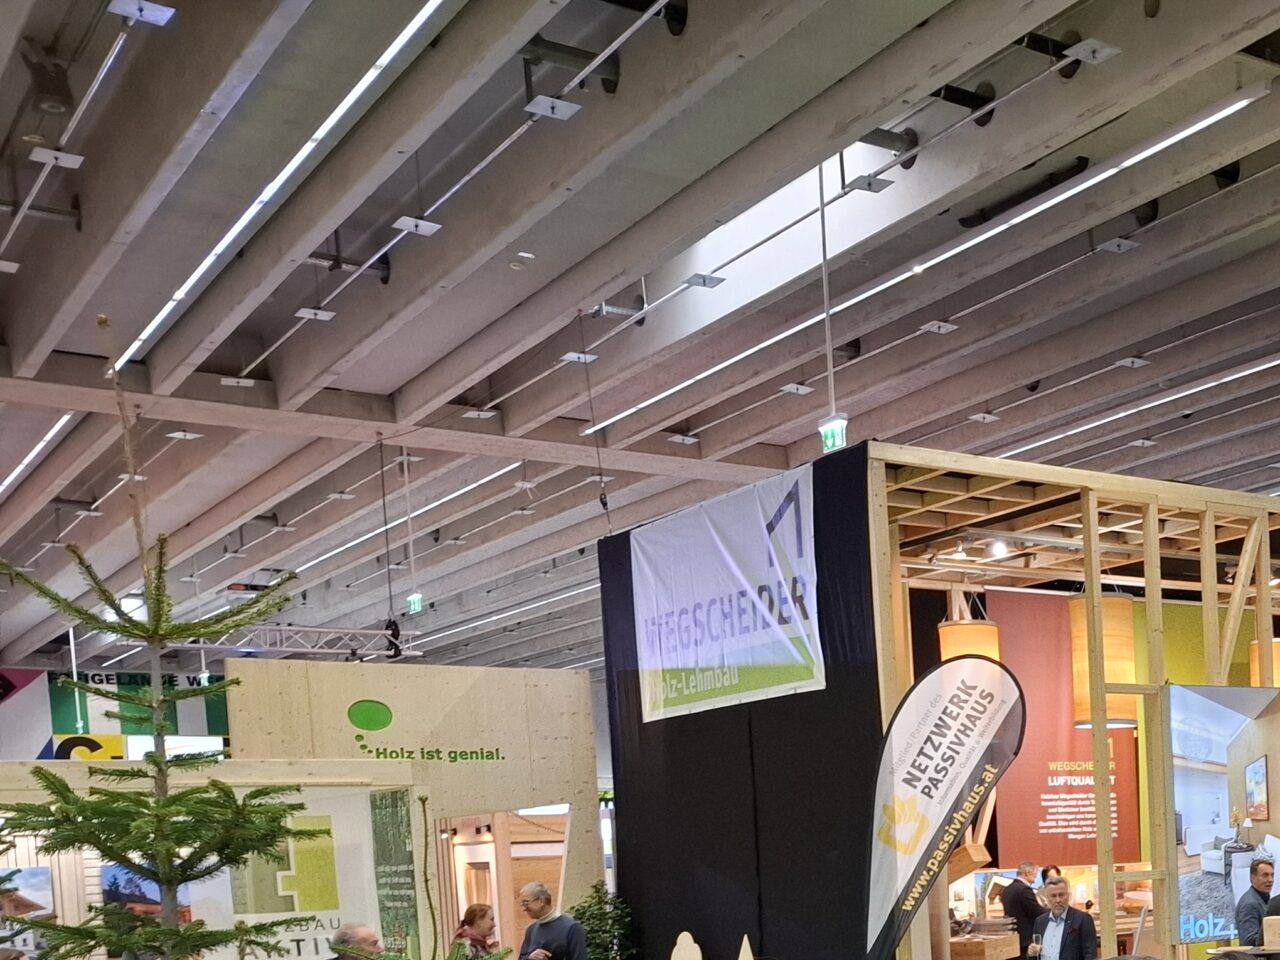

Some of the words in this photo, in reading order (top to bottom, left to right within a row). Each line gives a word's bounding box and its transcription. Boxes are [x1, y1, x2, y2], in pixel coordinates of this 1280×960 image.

[375, 747, 415, 760] Holz
[420, 747, 443, 760] ist
[448, 747, 506, 763] genial.
[902, 678, 978, 789] NETZWERK
[921, 689, 995, 799] PASSIVHAUS
[902, 763, 998, 911] www.passivhaus.at
